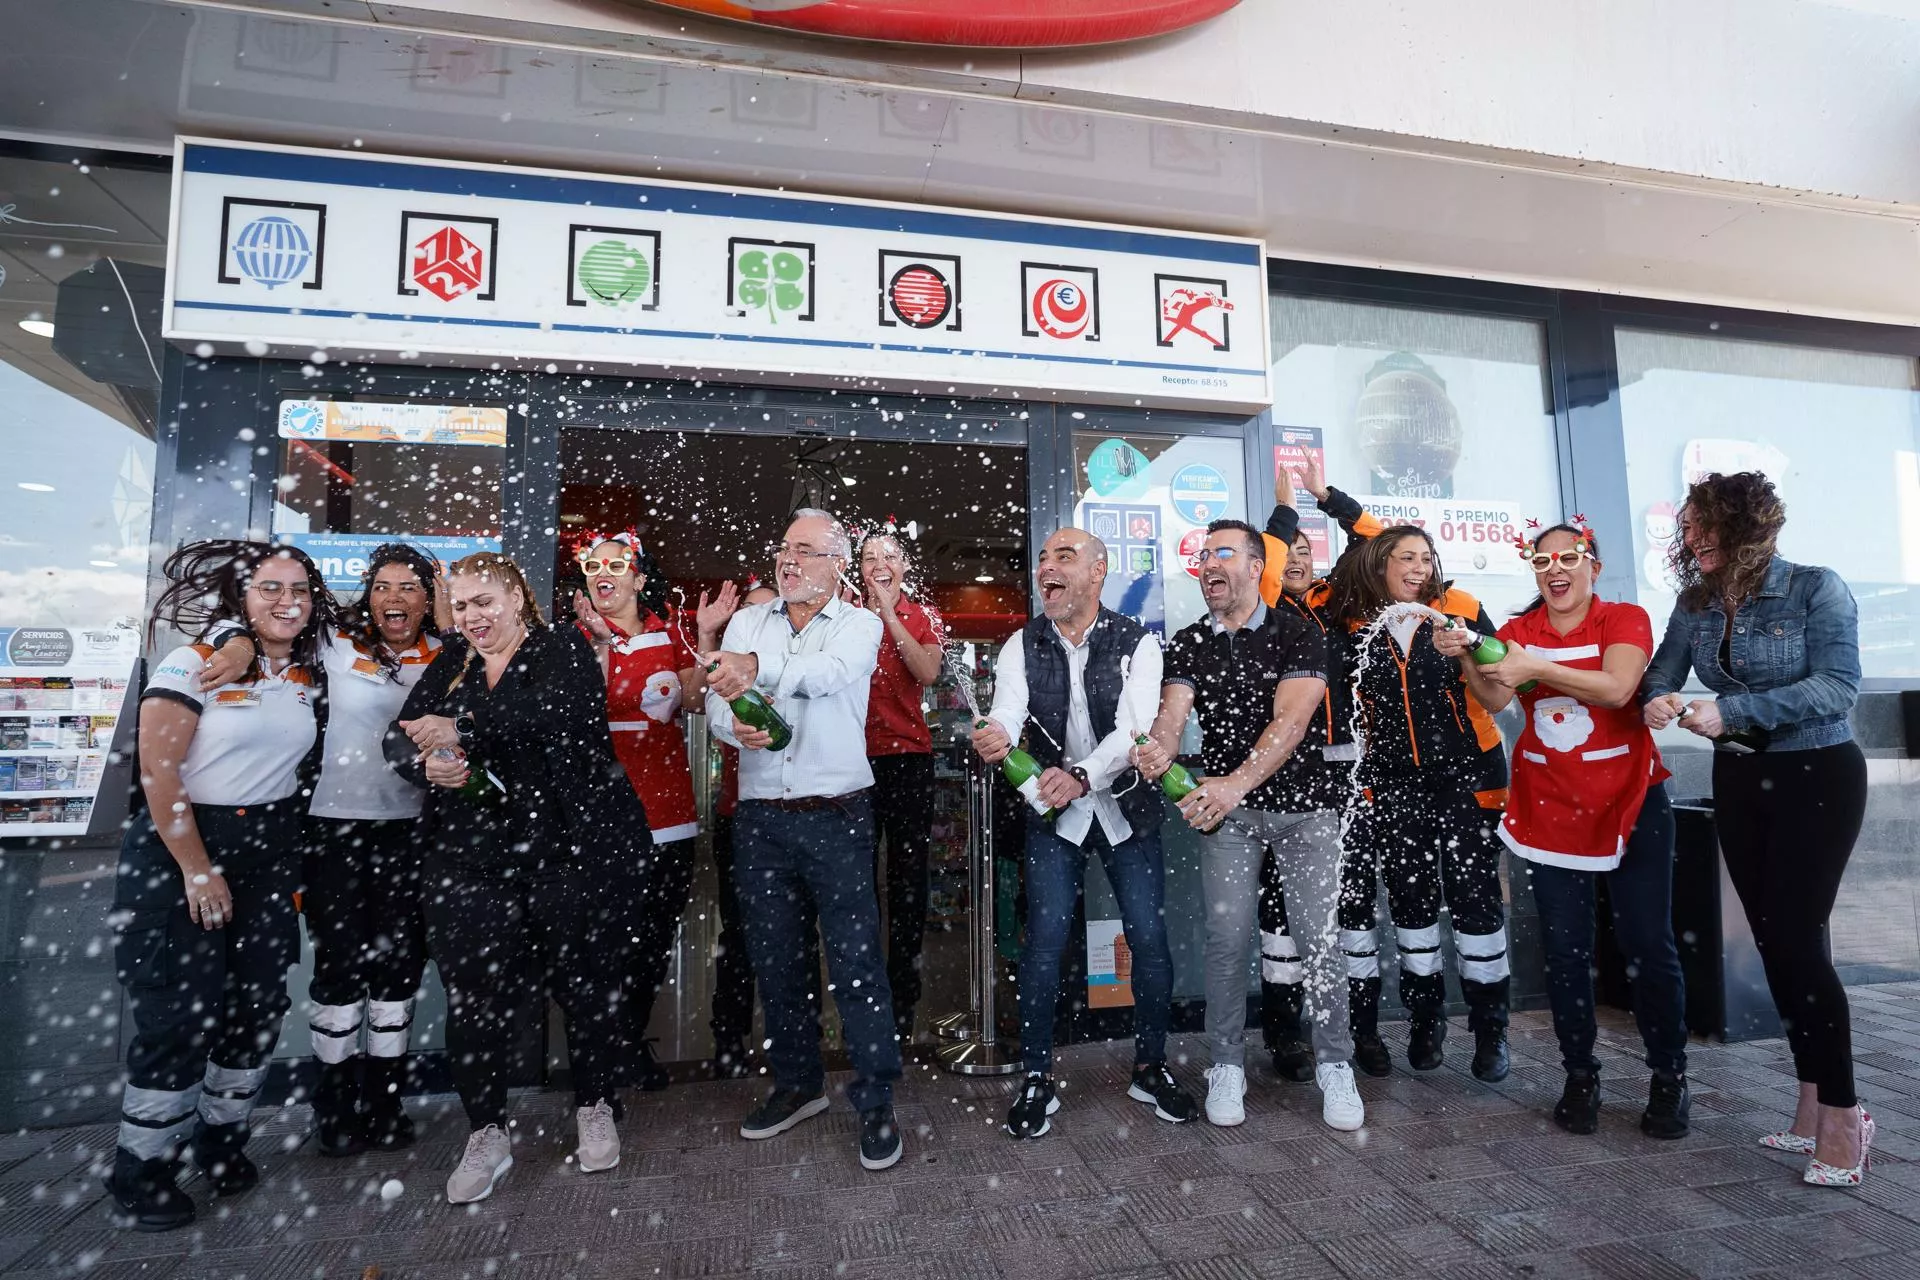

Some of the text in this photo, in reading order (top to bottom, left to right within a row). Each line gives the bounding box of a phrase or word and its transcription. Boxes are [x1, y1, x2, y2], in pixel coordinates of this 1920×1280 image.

[424, 237, 479, 275] 1 X
[428, 271, 468, 296] 2
[1162, 375, 1198, 385] Receptor
[282, 403, 298, 426] ONDA
[1280, 448, 1319, 458] ALARA
[1362, 504, 1420, 518] PREMIO
[1443, 509, 1509, 523] 5 PREMIO
[1440, 521, 1515, 544] 01568
[22, 631, 64, 639] SERVICIOS
